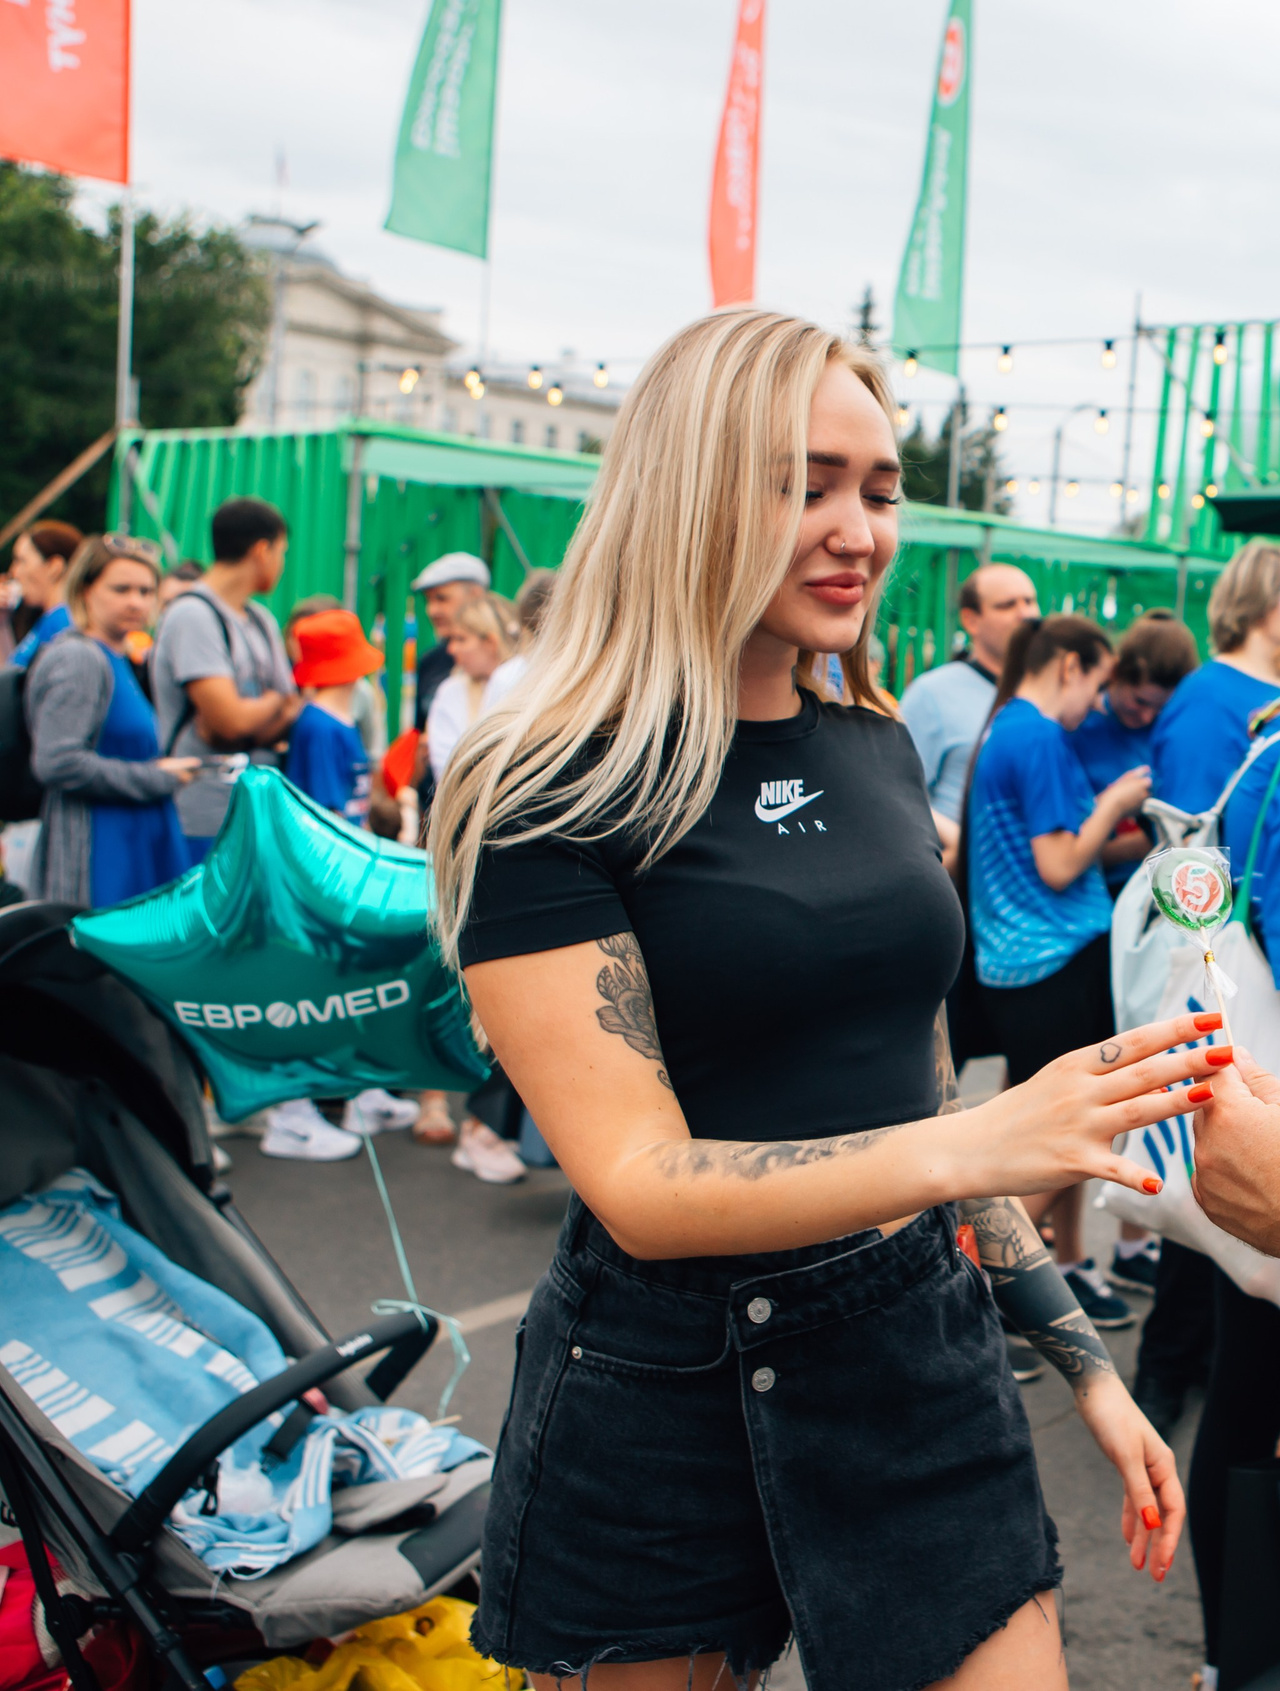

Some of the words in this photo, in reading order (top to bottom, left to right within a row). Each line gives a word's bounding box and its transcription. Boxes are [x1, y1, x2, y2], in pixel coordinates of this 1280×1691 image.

[760, 778, 805, 806] NIKE
[777, 820, 828, 835] AIR
[1186, 865, 1211, 907] 5
